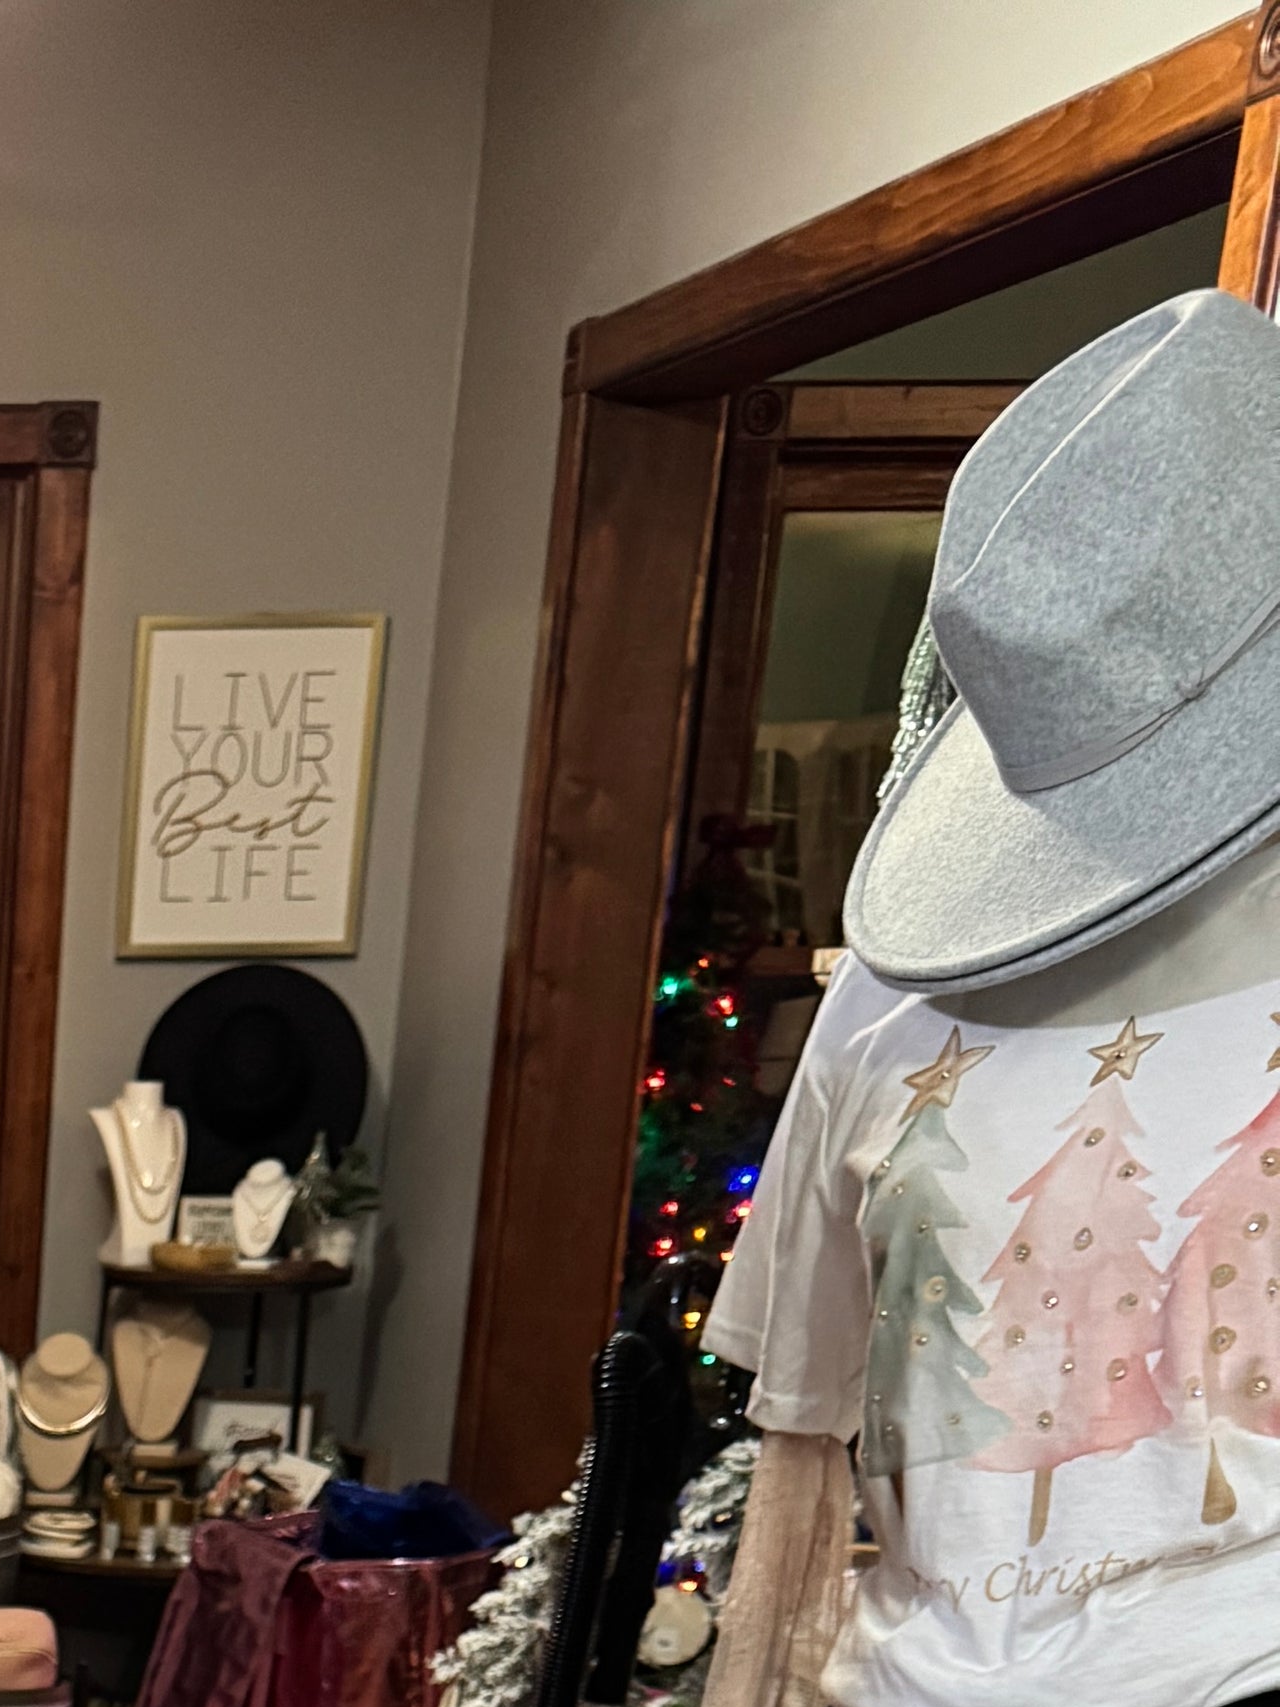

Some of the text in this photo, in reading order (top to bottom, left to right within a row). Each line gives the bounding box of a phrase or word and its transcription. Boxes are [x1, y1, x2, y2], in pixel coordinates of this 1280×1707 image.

[172, 669, 337, 731] LIVE
[170, 730, 334, 789] YOUR
[150, 769, 334, 858] Best
[159, 844, 322, 903] LIFE
